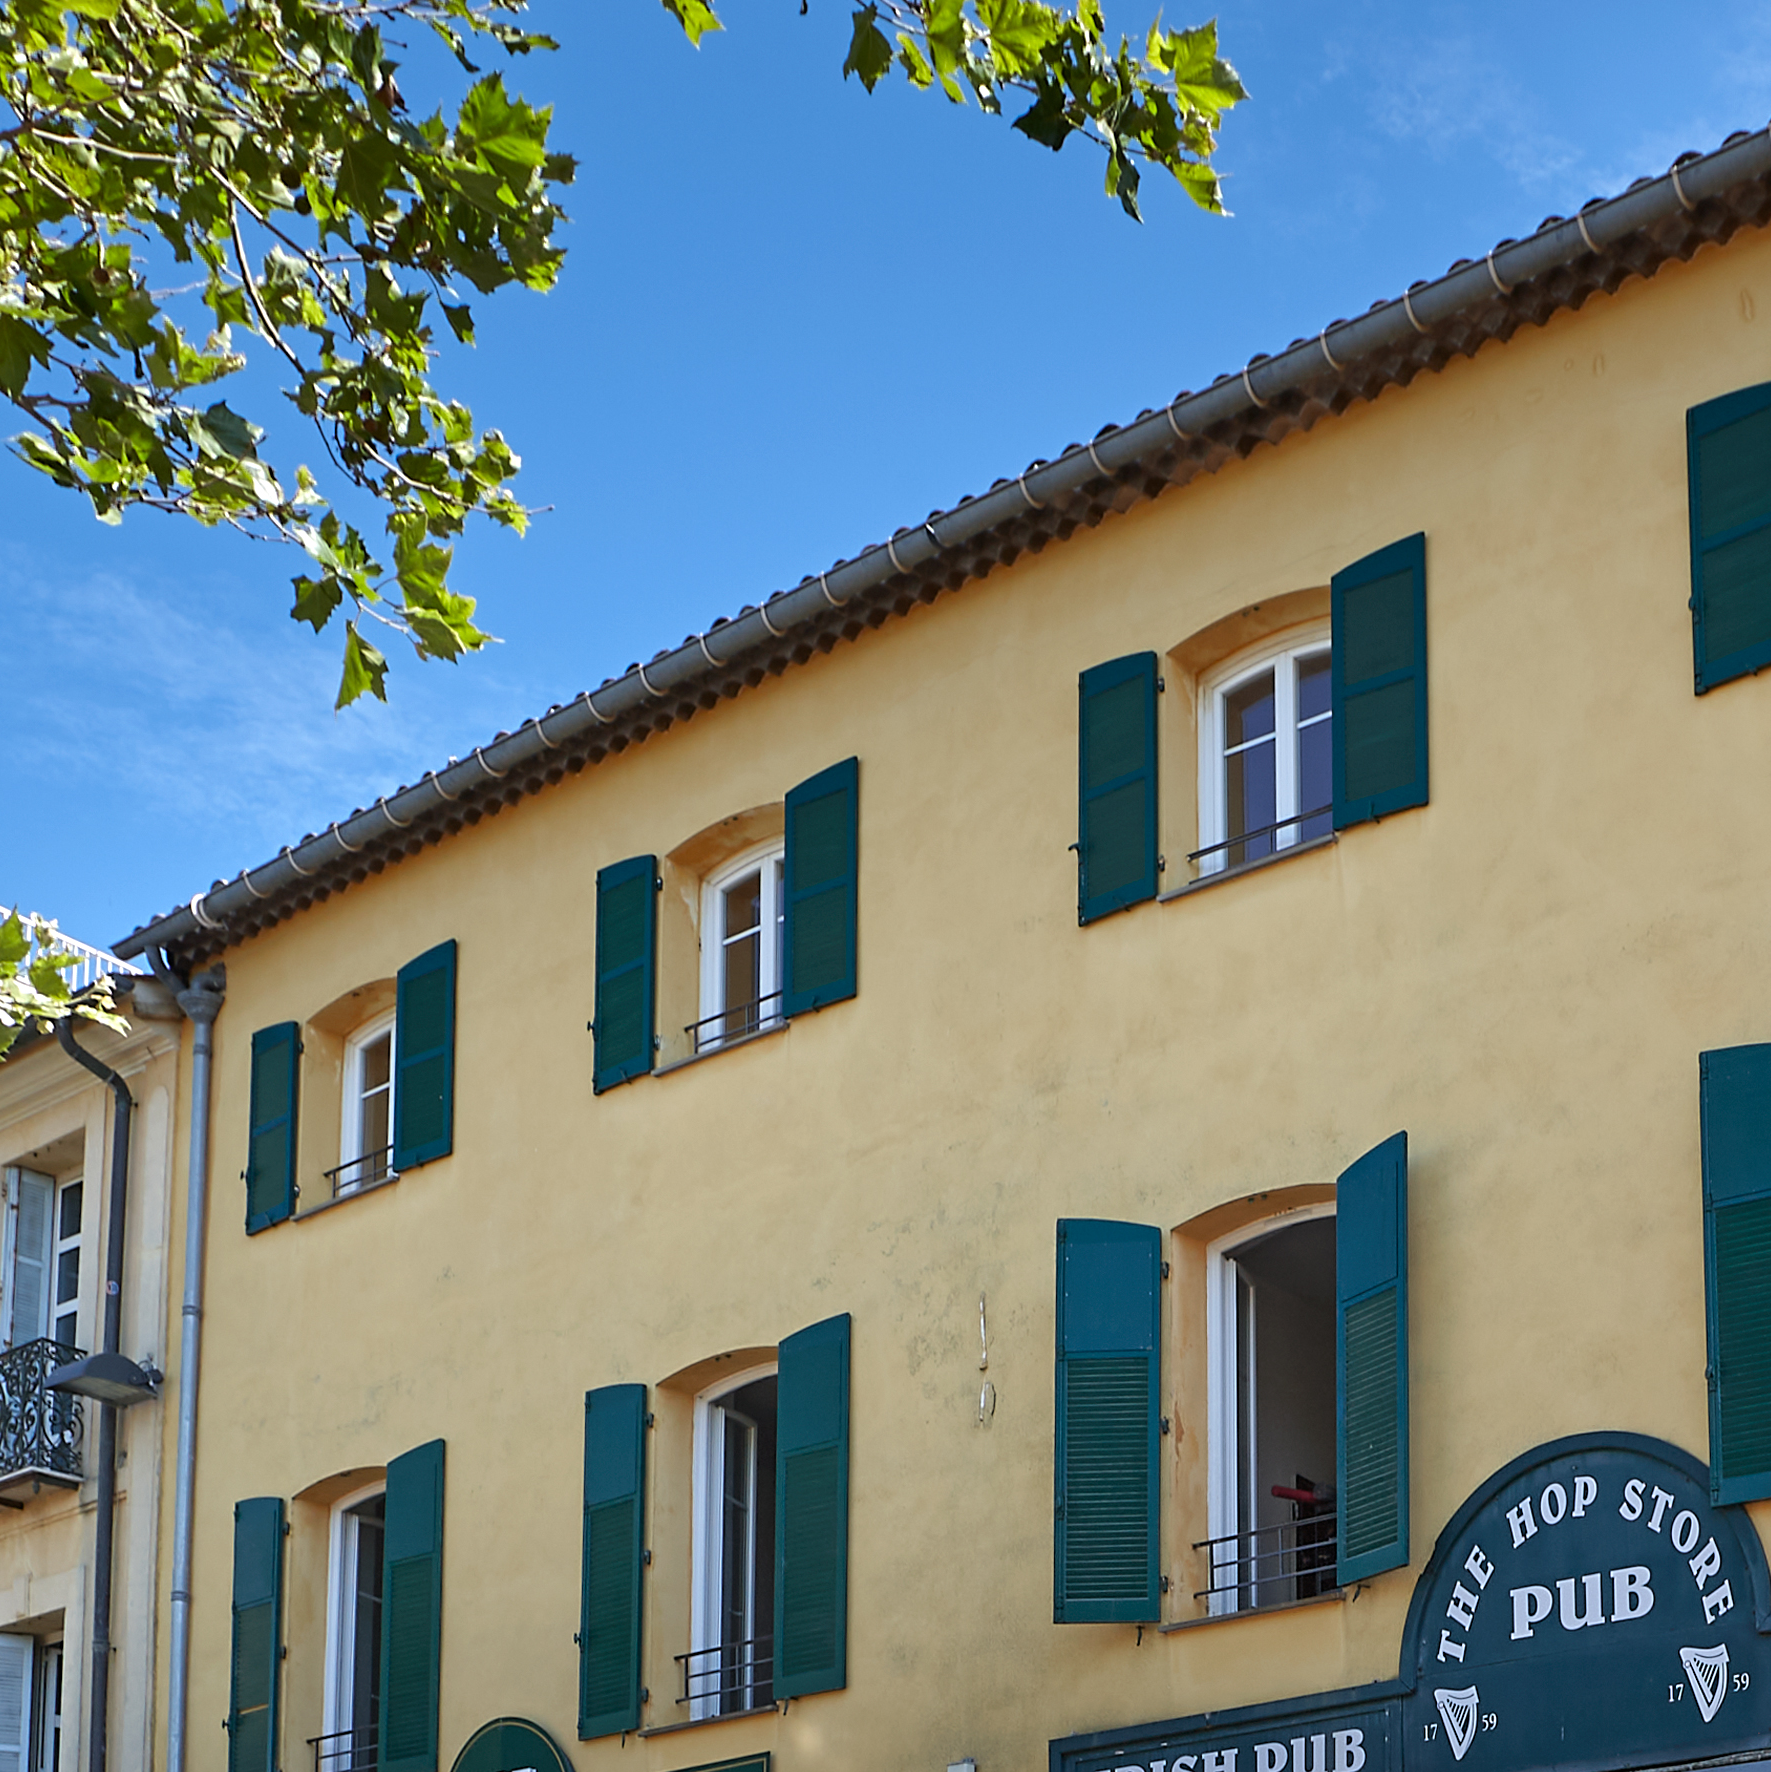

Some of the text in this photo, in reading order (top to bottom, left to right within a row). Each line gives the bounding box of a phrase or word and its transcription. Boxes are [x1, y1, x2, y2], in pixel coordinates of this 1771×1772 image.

[1437, 1475, 1735, 1663] THE HOP STORE
[1510, 1565, 1655, 1640] PUB
[1667, 1672, 1750, 1703] 17 59
[1423, 1712, 1497, 1742] 17 59
